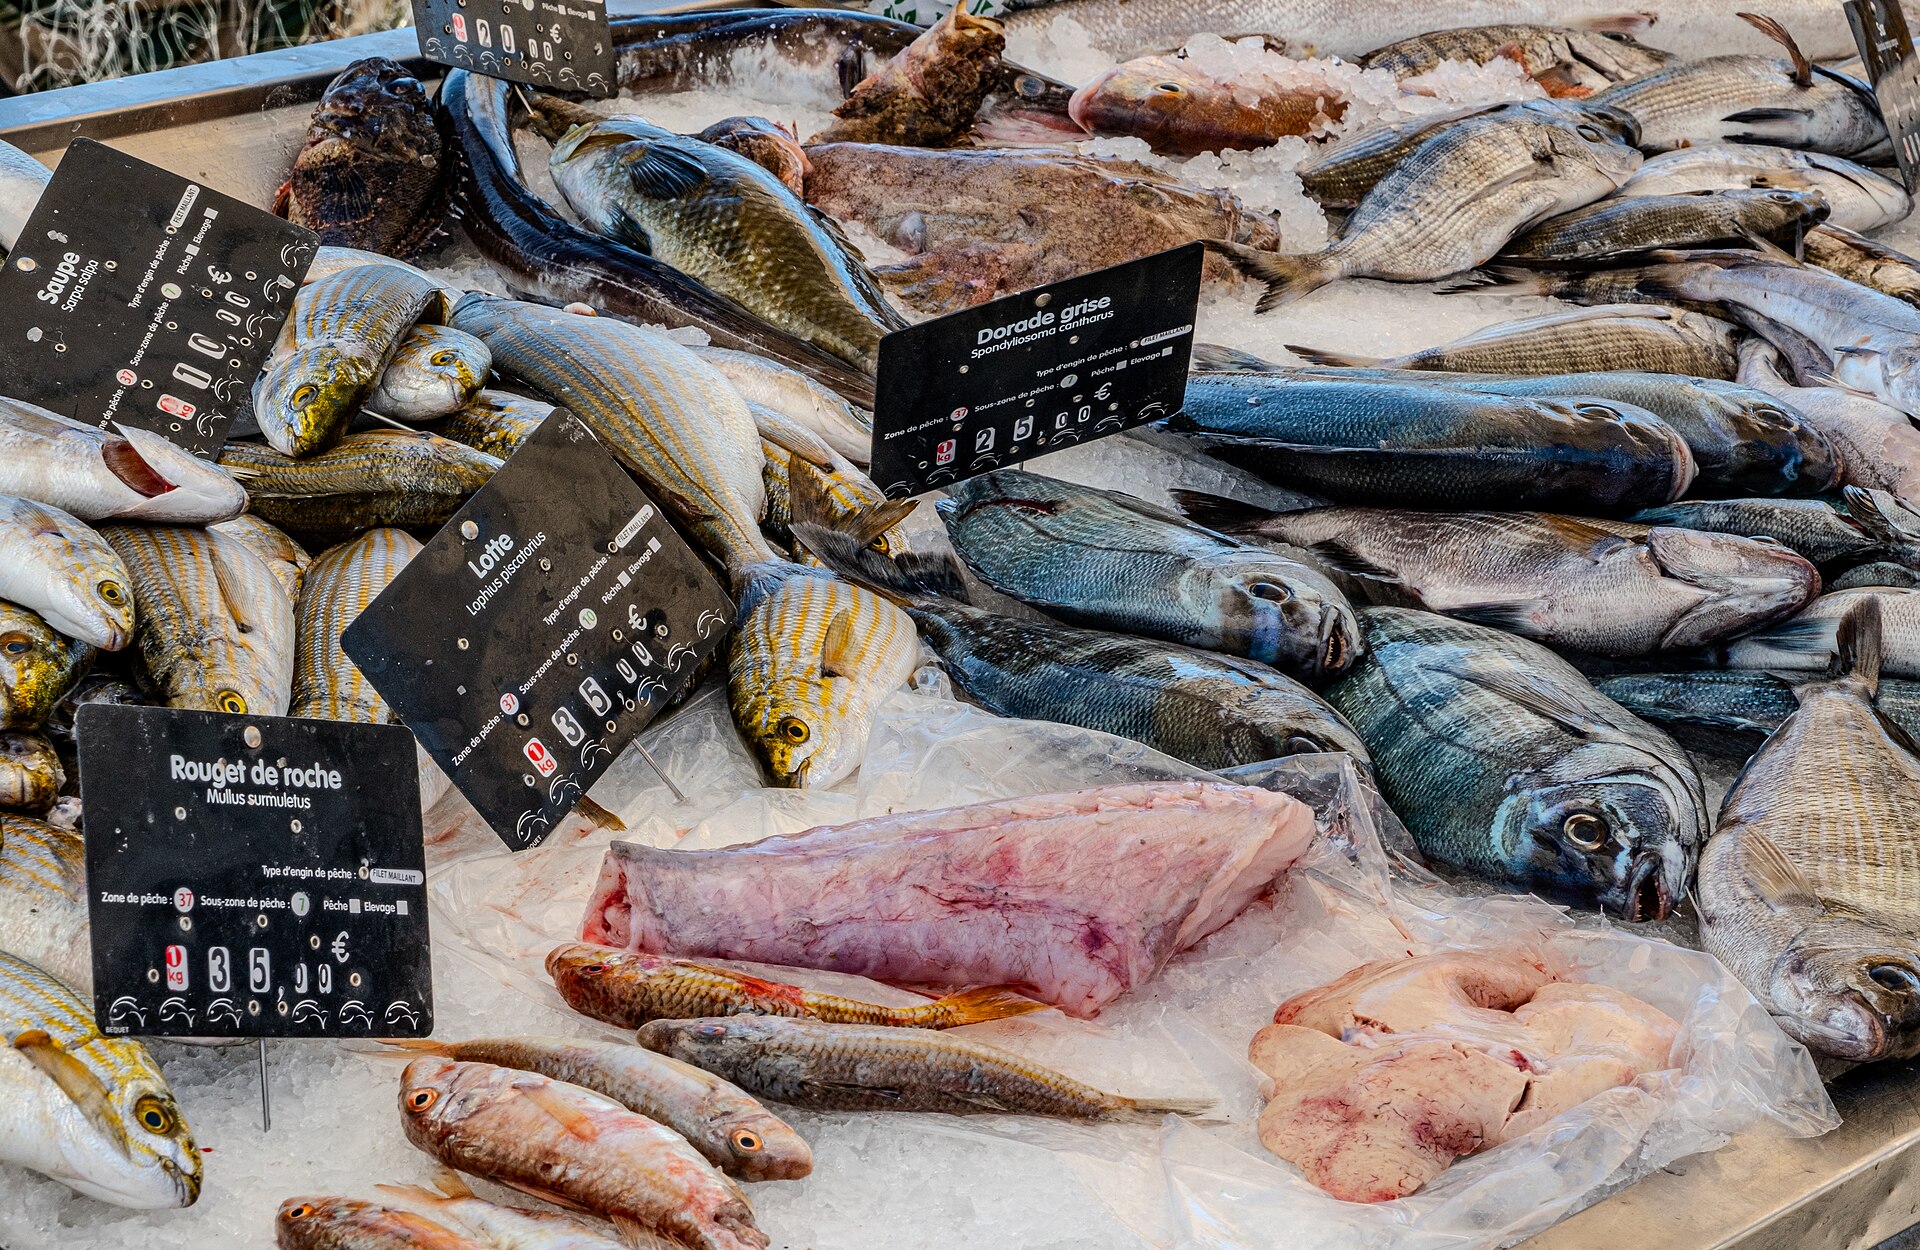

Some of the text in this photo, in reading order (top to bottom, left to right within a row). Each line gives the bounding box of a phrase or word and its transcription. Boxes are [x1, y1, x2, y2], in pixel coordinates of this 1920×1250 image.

[550, 23, 562, 44] €
[193, 219, 211, 244] Elevage
[128, 293, 142, 308] Type
[137, 269, 155, 293] d'engin
[149, 260, 160, 269] de
[172, 209, 186, 224] FILET
[179, 187, 197, 211] MAILLANT
[177, 255, 193, 275] Pêche
[207, 265, 232, 284] €
[37, 252, 80, 304] Saupe
[61, 260, 99, 312] Sarpa salpa
[163, 286, 177, 296] 7
[148, 323, 158, 332] de
[977, 297, 1111, 345] Dorade grise
[971, 310, 1114, 358] Spondyliosoma cantharus
[130, 332, 153, 366] Sous-zone
[1036, 368, 1054, 377] Type
[1056, 358, 1085, 371] d'engin
[1157, 325, 1186, 339] MAILLANT
[118, 369, 135, 384] 37
[884, 430, 905, 440] Zone
[953, 407, 967, 419] 37
[975, 396, 1016, 412] Sous-zone
[1067, 375, 1073, 384] 7
[1091, 366, 1115, 377] Pêche
[1131, 352, 1160, 365] Elevage
[1094, 382, 1112, 400] €
[102, 407, 115, 419] de
[177, 403, 194, 419] kg
[99, 417, 109, 430] ne
[936, 452, 951, 463] kg
[468, 534, 514, 579] Lotte
[543, 609, 560, 625] Type
[559, 585, 582, 610] d'engin
[580, 576, 590, 587] de
[615, 528, 631, 545] FILET
[626, 509, 651, 536] MAILLANT
[466, 532, 546, 616] Lophius piscatorius
[628, 604, 647, 630] €
[452, 746, 472, 766] Zone
[470, 736, 481, 747] de
[500, 692, 518, 712] 37
[519, 659, 553, 694] Sous-zone
[551, 649, 561, 660] de
[580, 608, 597, 627] 10
[601, 583, 622, 604] Pêche
[628, 549, 652, 574] Elevage
[170, 755, 342, 790] Rouget de roche
[536, 754, 556, 776] kg
[207, 788, 311, 809] Mullus surmuletus
[262, 865, 281, 878] Type
[282, 866, 313, 879] d'engin
[315, 867, 326, 878] de
[372, 868, 387, 879] FILET
[387, 870, 416, 883] MAILLANT
[101, 892, 125, 903] Zone
[127, 892, 139, 903] de
[178, 892, 193, 907] 37
[201, 895, 245, 909] Sous-zone
[247, 897, 258, 908] de
[298, 897, 306, 911] 7
[323, 897, 348, 911] Pêche
[364, 901, 396, 915] Elevage
[331, 931, 350, 963] €
[167, 967, 183, 985] kg
